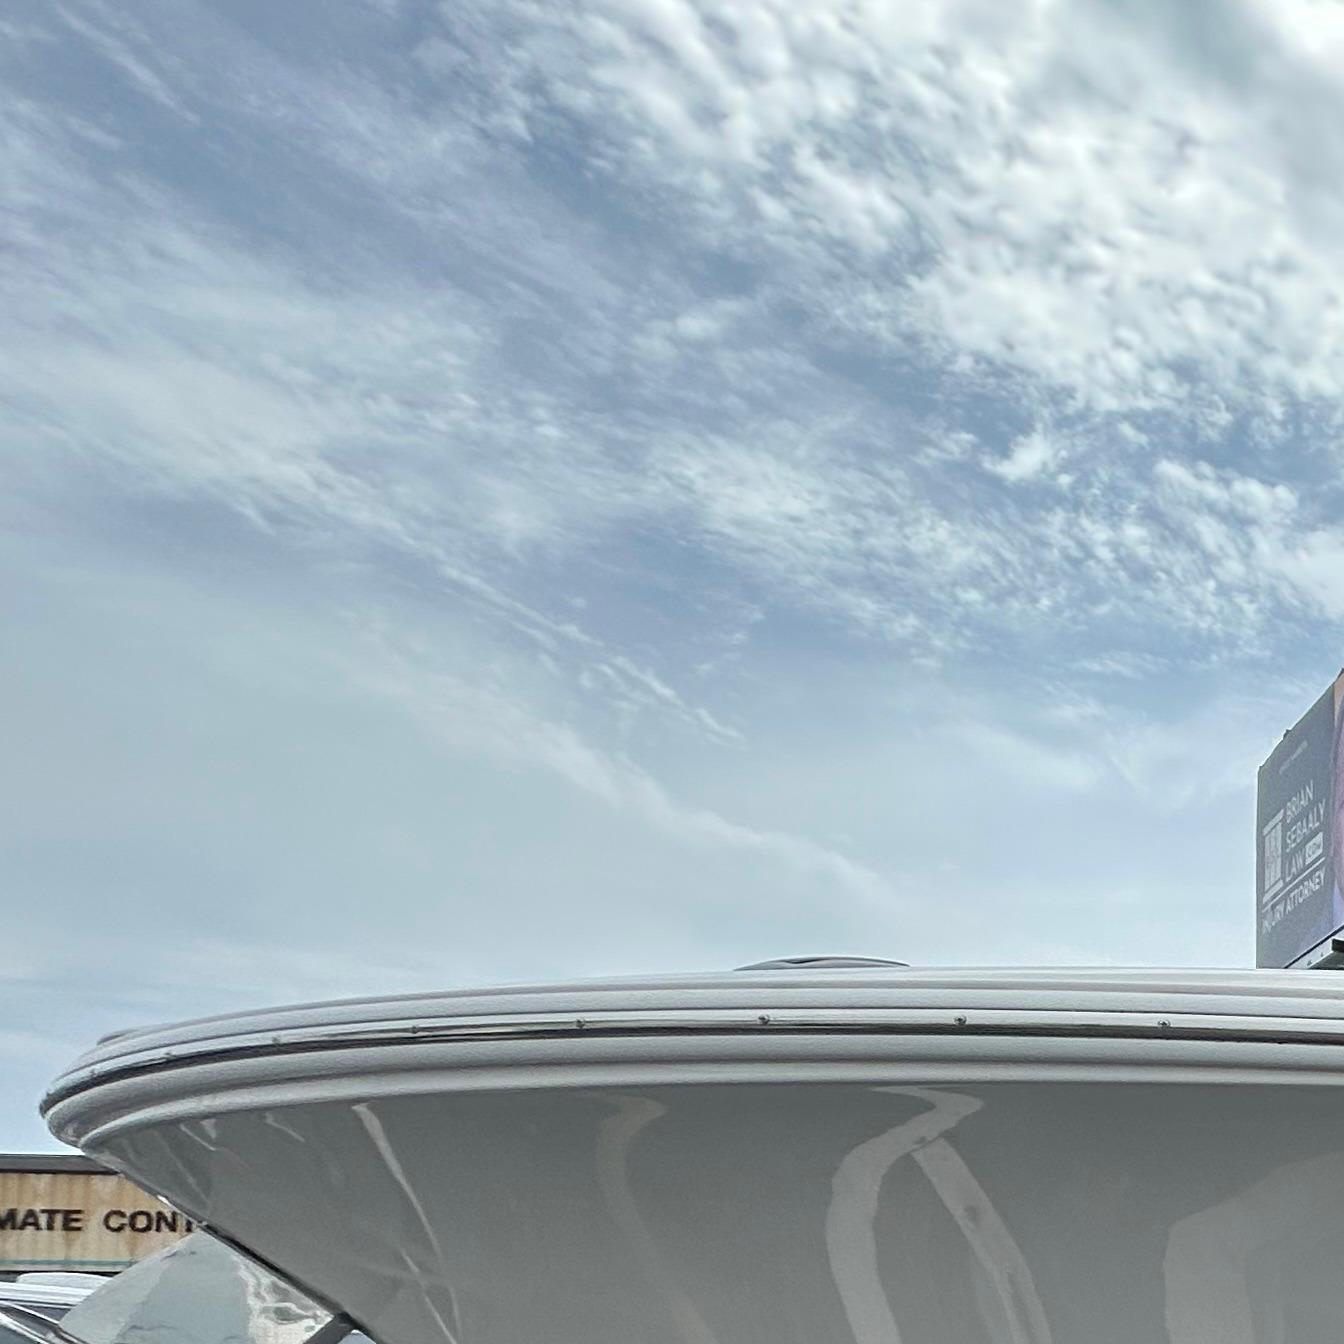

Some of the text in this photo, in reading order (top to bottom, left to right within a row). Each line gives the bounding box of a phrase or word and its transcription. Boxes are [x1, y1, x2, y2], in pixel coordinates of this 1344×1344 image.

[1286, 780, 1314, 823] BRIAN
[1286, 798, 1326, 852] SEBAALY
[1285, 847, 1305, 882] LAW
[1285, 867, 1326, 915] ATTORNEY
